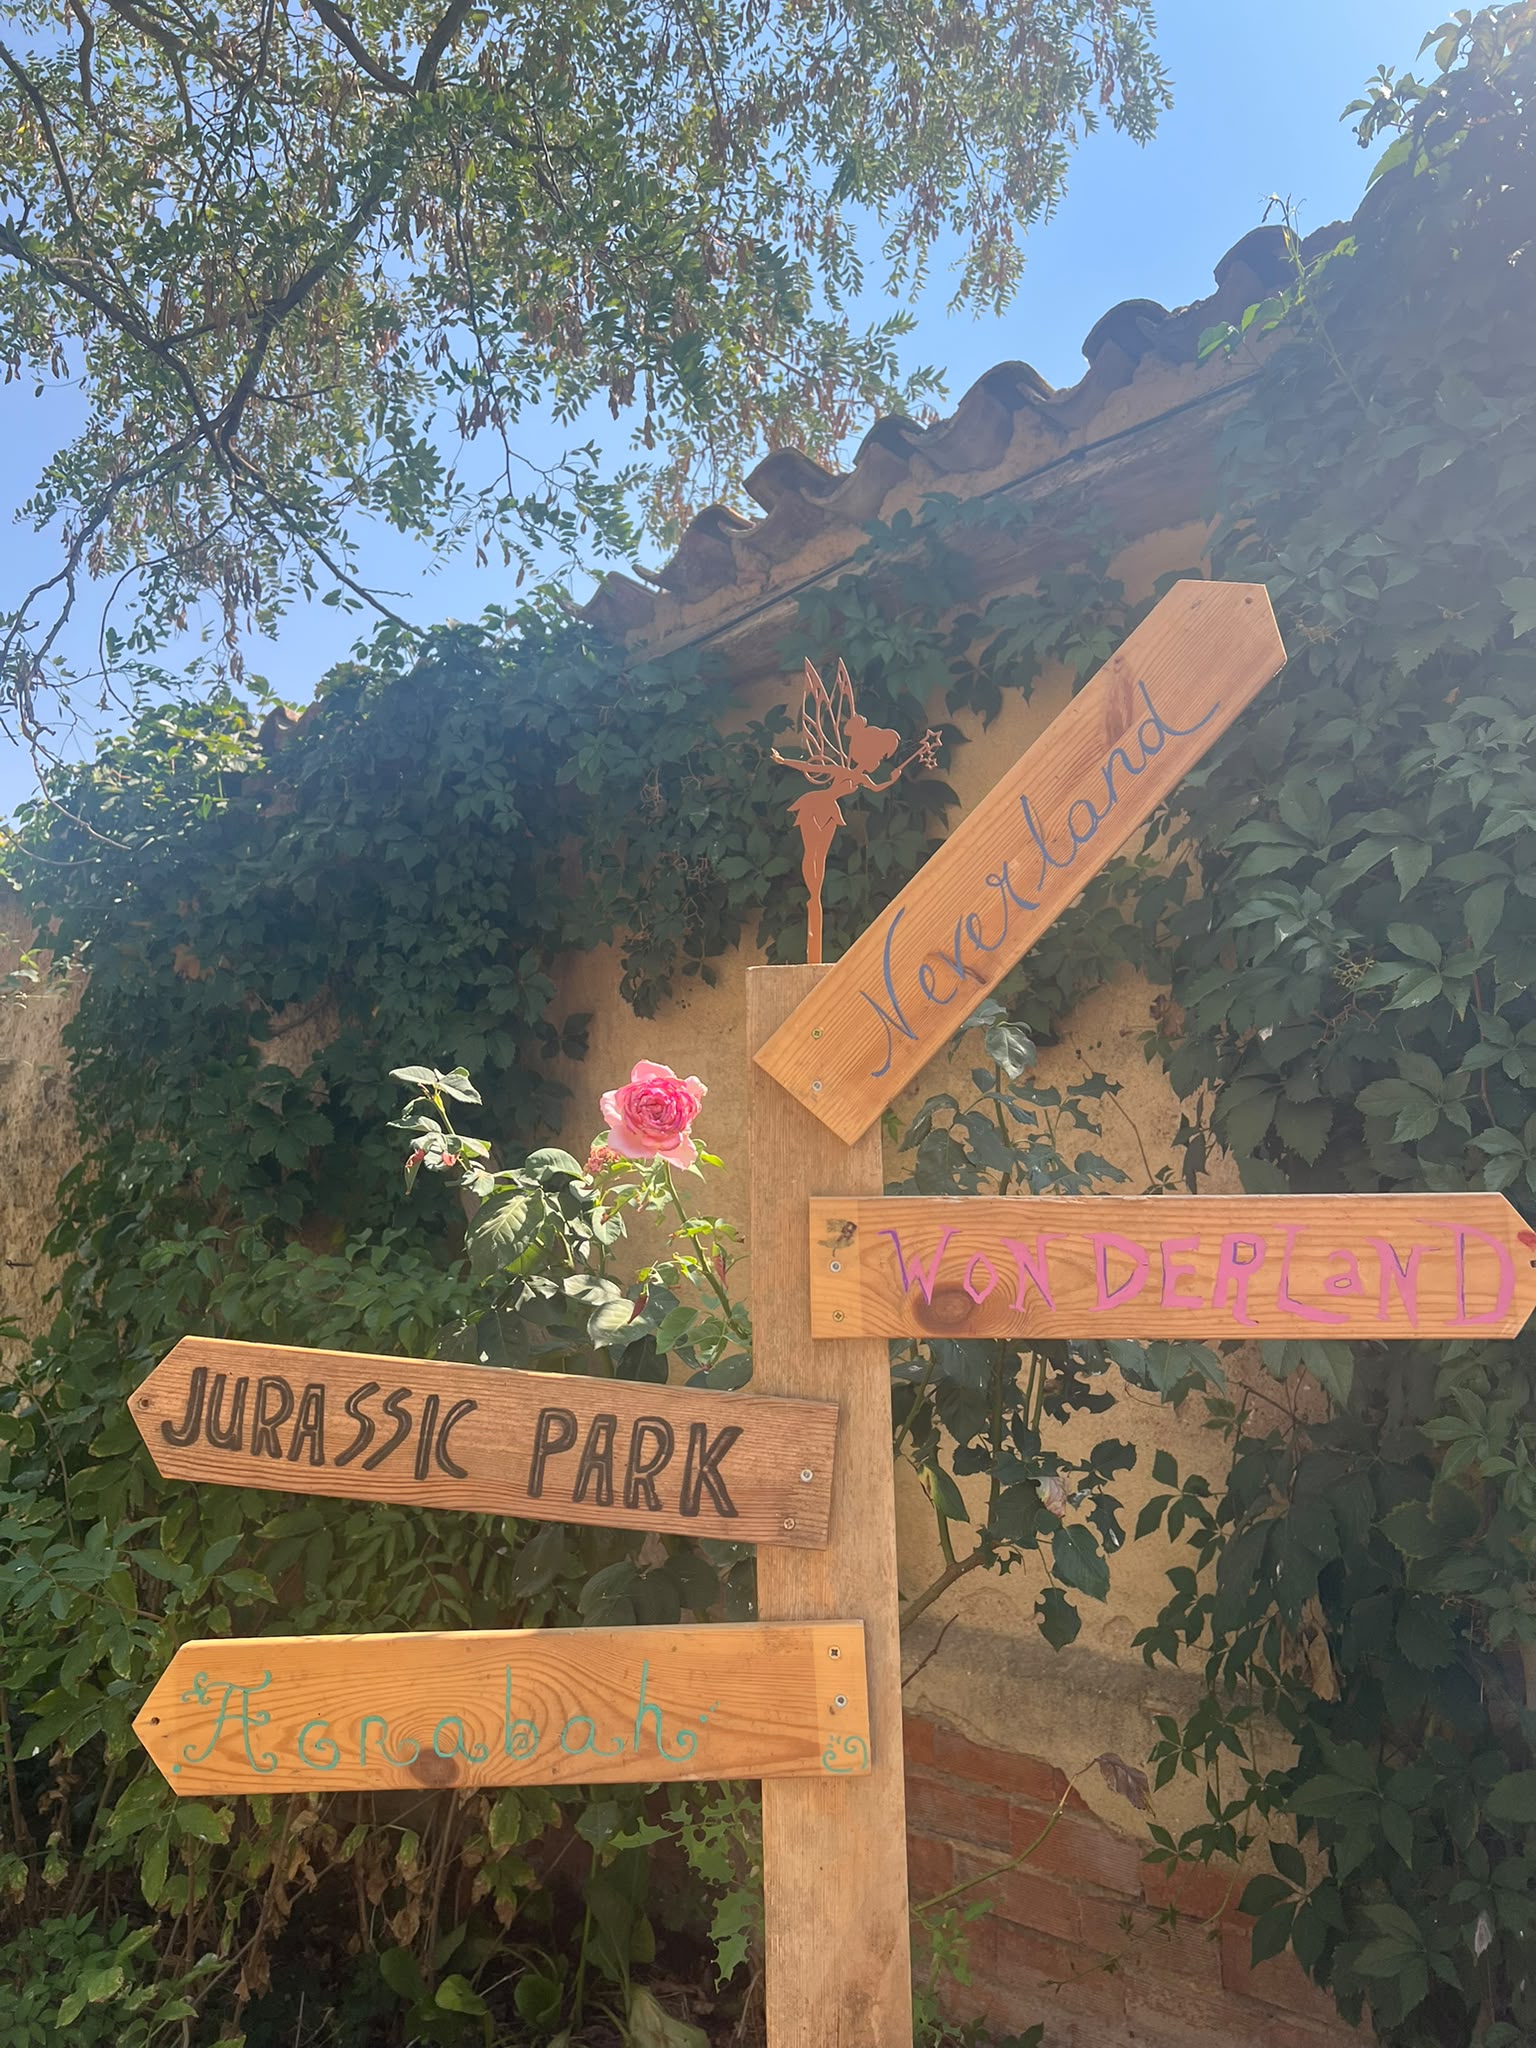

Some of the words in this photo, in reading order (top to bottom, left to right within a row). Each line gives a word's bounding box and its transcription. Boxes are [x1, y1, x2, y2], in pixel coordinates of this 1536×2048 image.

[859, 679, 1220, 1078] Neverland
[161, 1367, 478, 1480] JURASSIC
[528, 1407, 744, 1518] PARK
